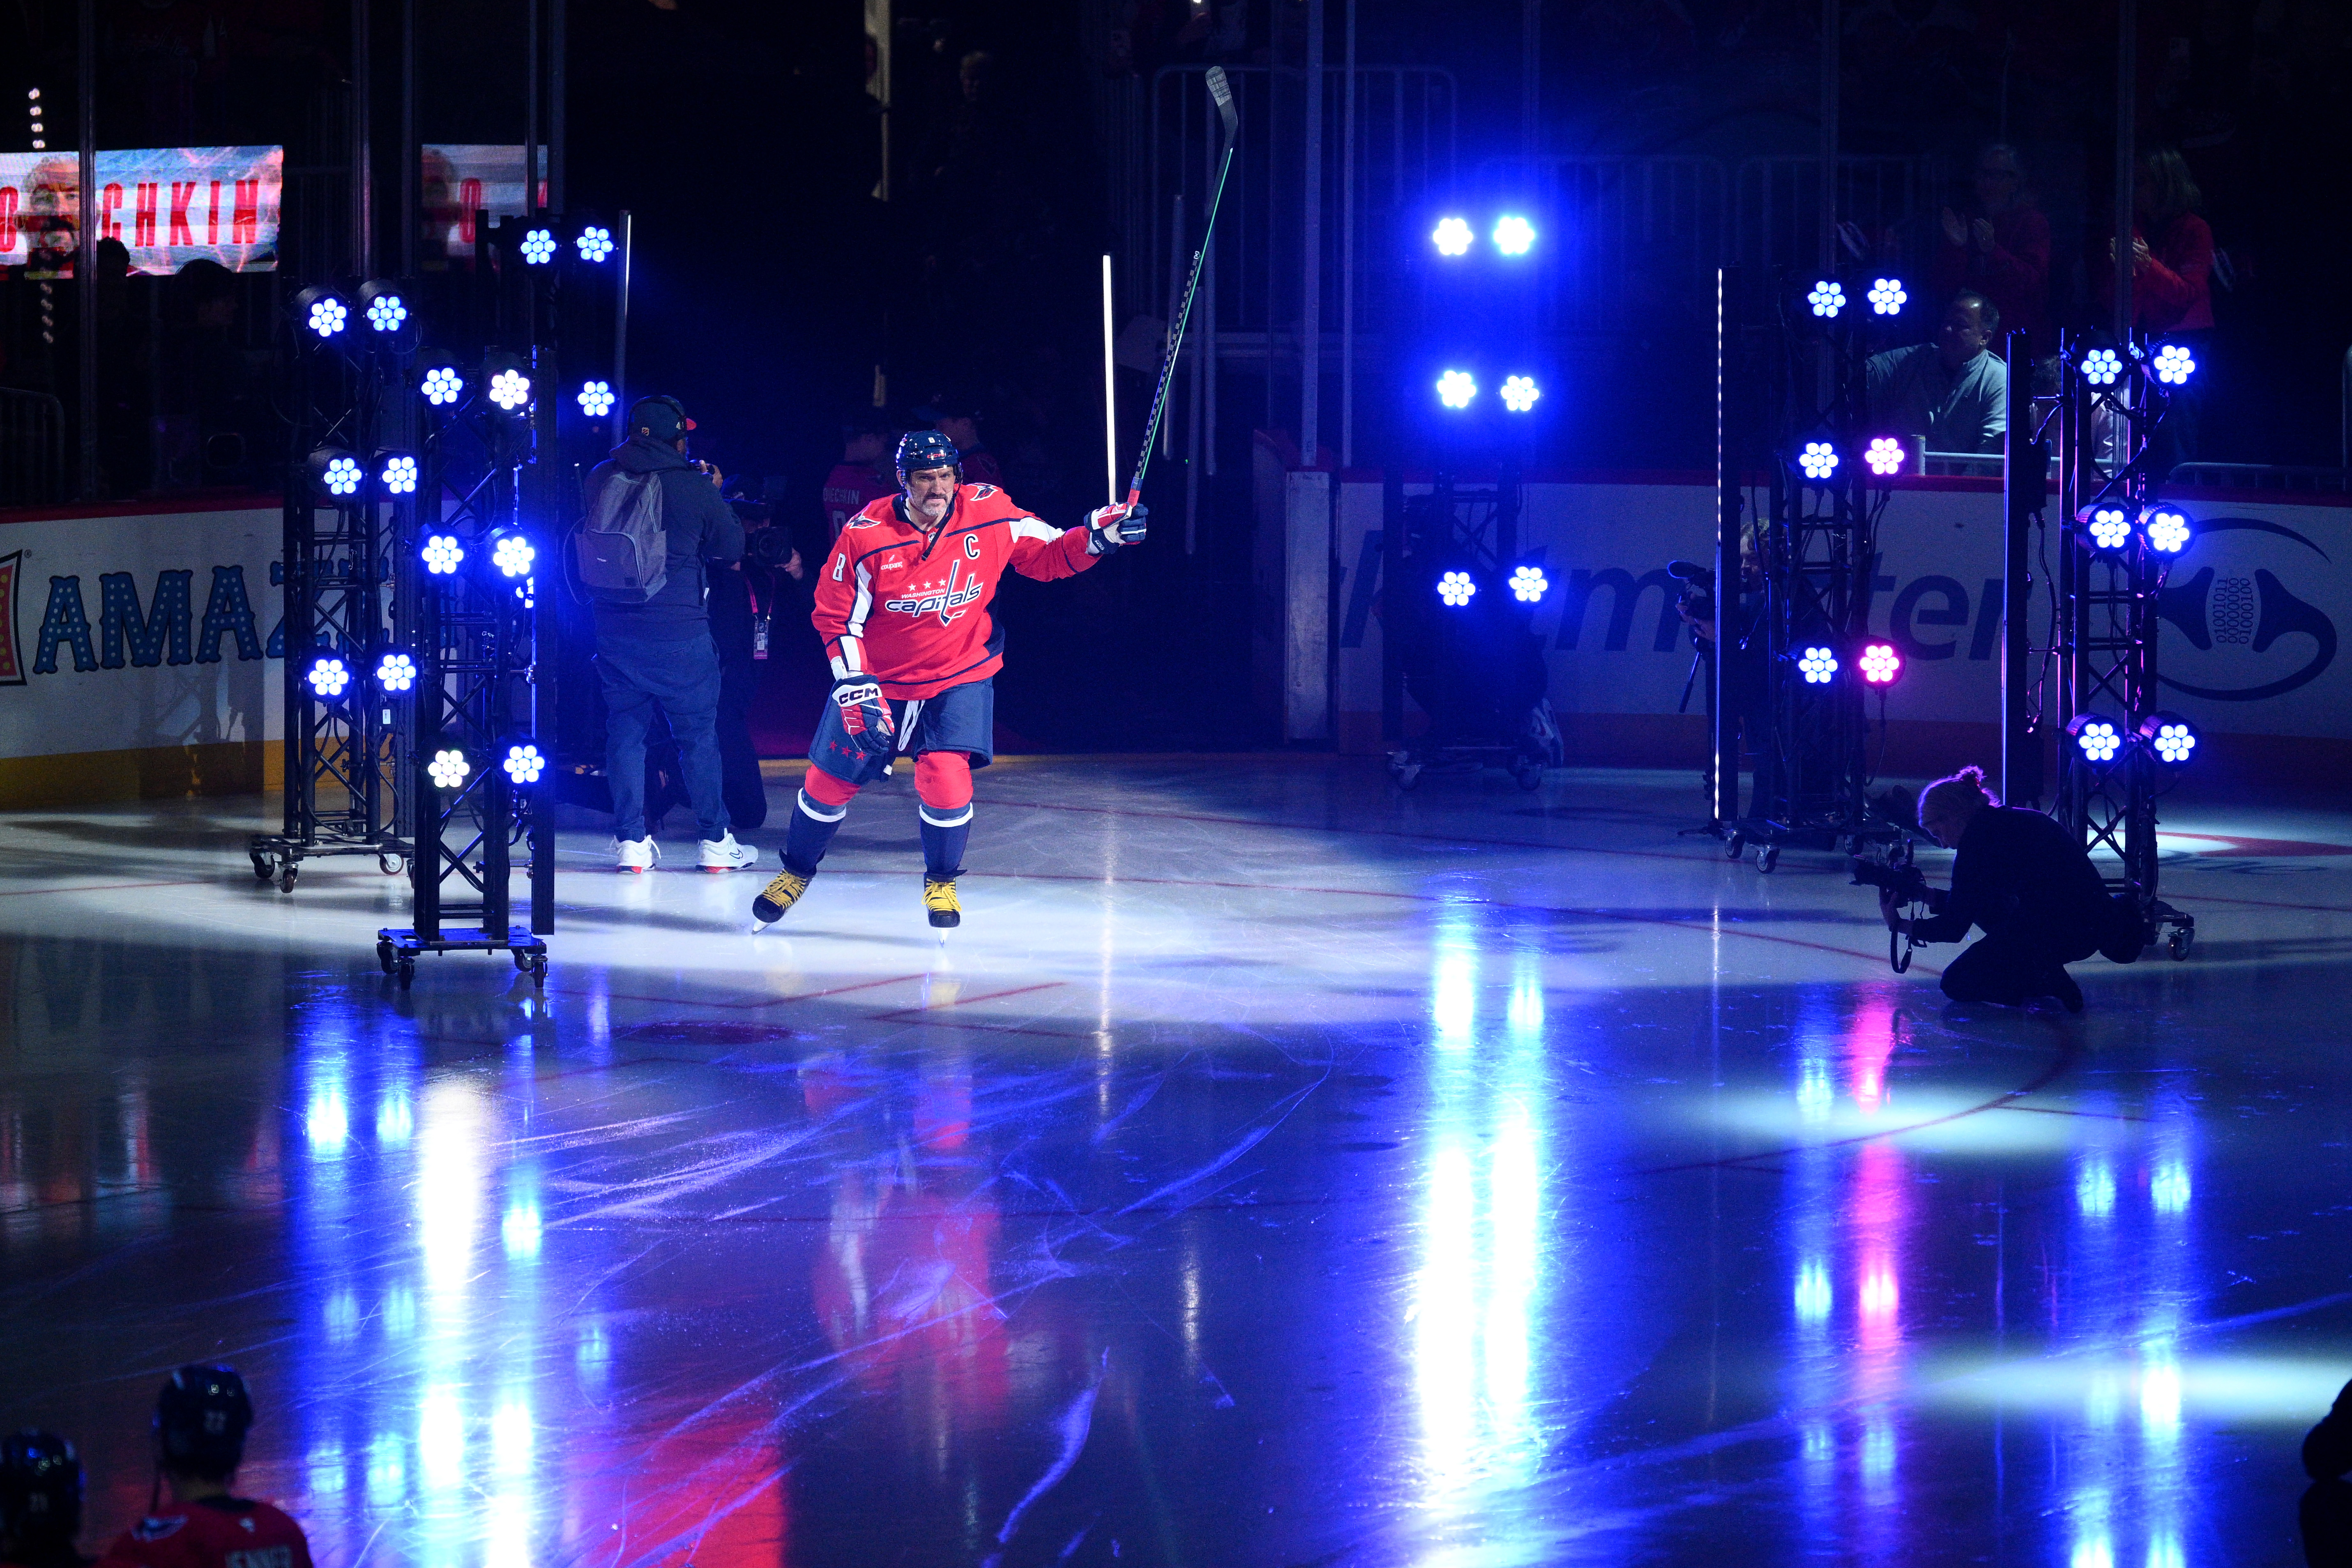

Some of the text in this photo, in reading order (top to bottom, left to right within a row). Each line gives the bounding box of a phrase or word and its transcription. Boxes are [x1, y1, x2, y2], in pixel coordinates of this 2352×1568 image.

[963, 534, 980, 560] C
[832, 553, 846, 582] 8
[881, 561, 903, 571] coupang
[885, 559, 984, 627] capitals
[901, 588, 945, 599] WASHINGTON
[839, 688, 878, 705] CCM
